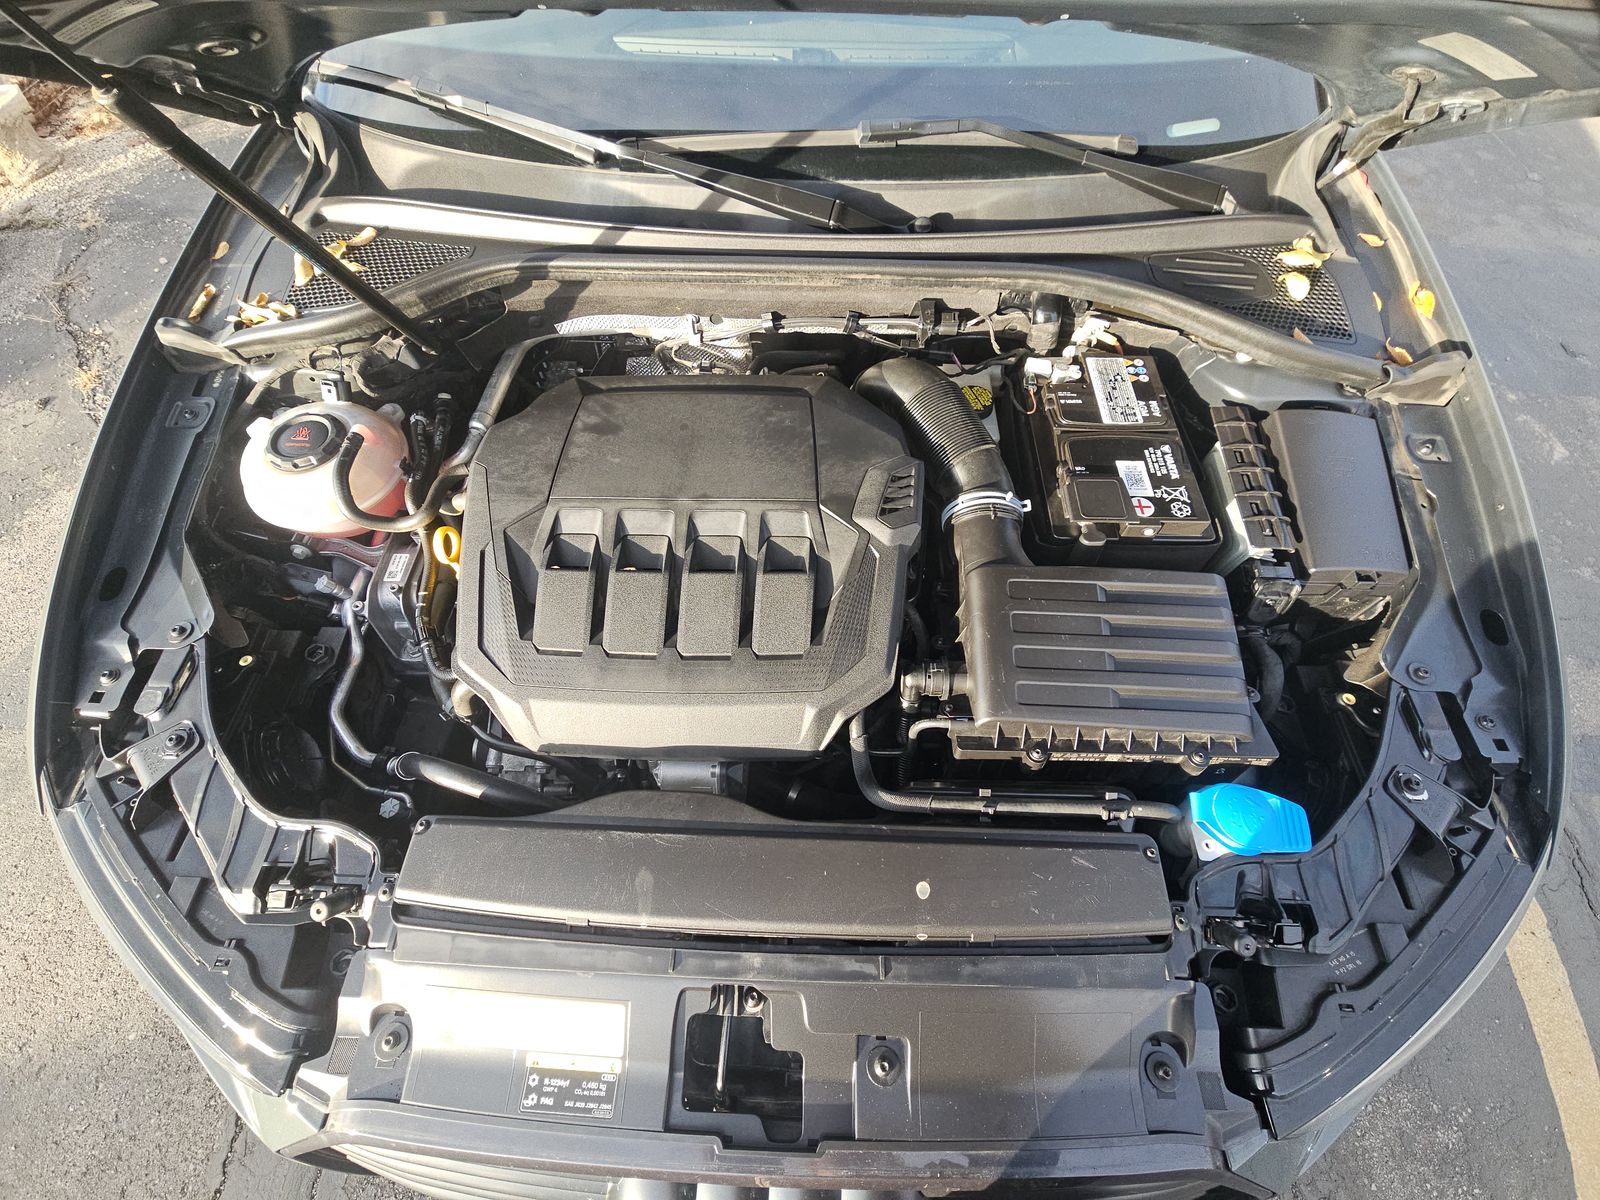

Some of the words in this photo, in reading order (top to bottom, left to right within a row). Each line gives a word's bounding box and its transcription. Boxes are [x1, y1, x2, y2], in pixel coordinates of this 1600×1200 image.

[1164, 453, 1180, 479] VARTA
[1154, 490, 1161, 498] Pb
[599, 1083, 607, 1091] kg
[540, 1096, 554, 1106] PAG
